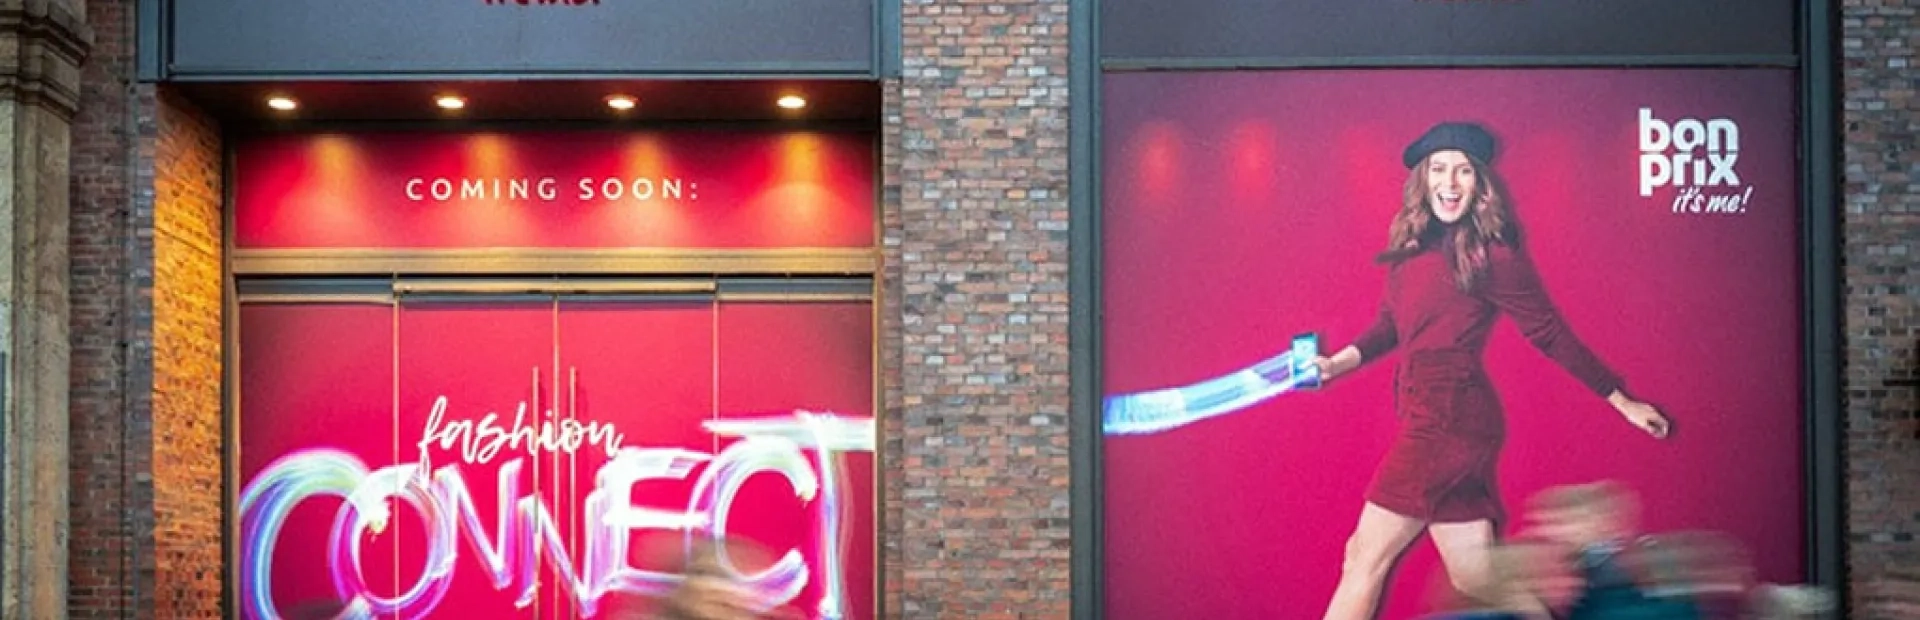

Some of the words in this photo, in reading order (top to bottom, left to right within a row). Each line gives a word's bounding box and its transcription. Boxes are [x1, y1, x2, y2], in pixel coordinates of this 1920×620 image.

[1639, 107, 1739, 151] bon
[405, 177, 558, 201] COMING
[578, 177, 698, 201] SOON:
[1639, 153, 1740, 197] prix
[1672, 186, 1705, 214] it's
[1705, 185, 1753, 214] me!
[416, 395, 624, 489] fashion
[240, 411, 875, 620] CONNECT
